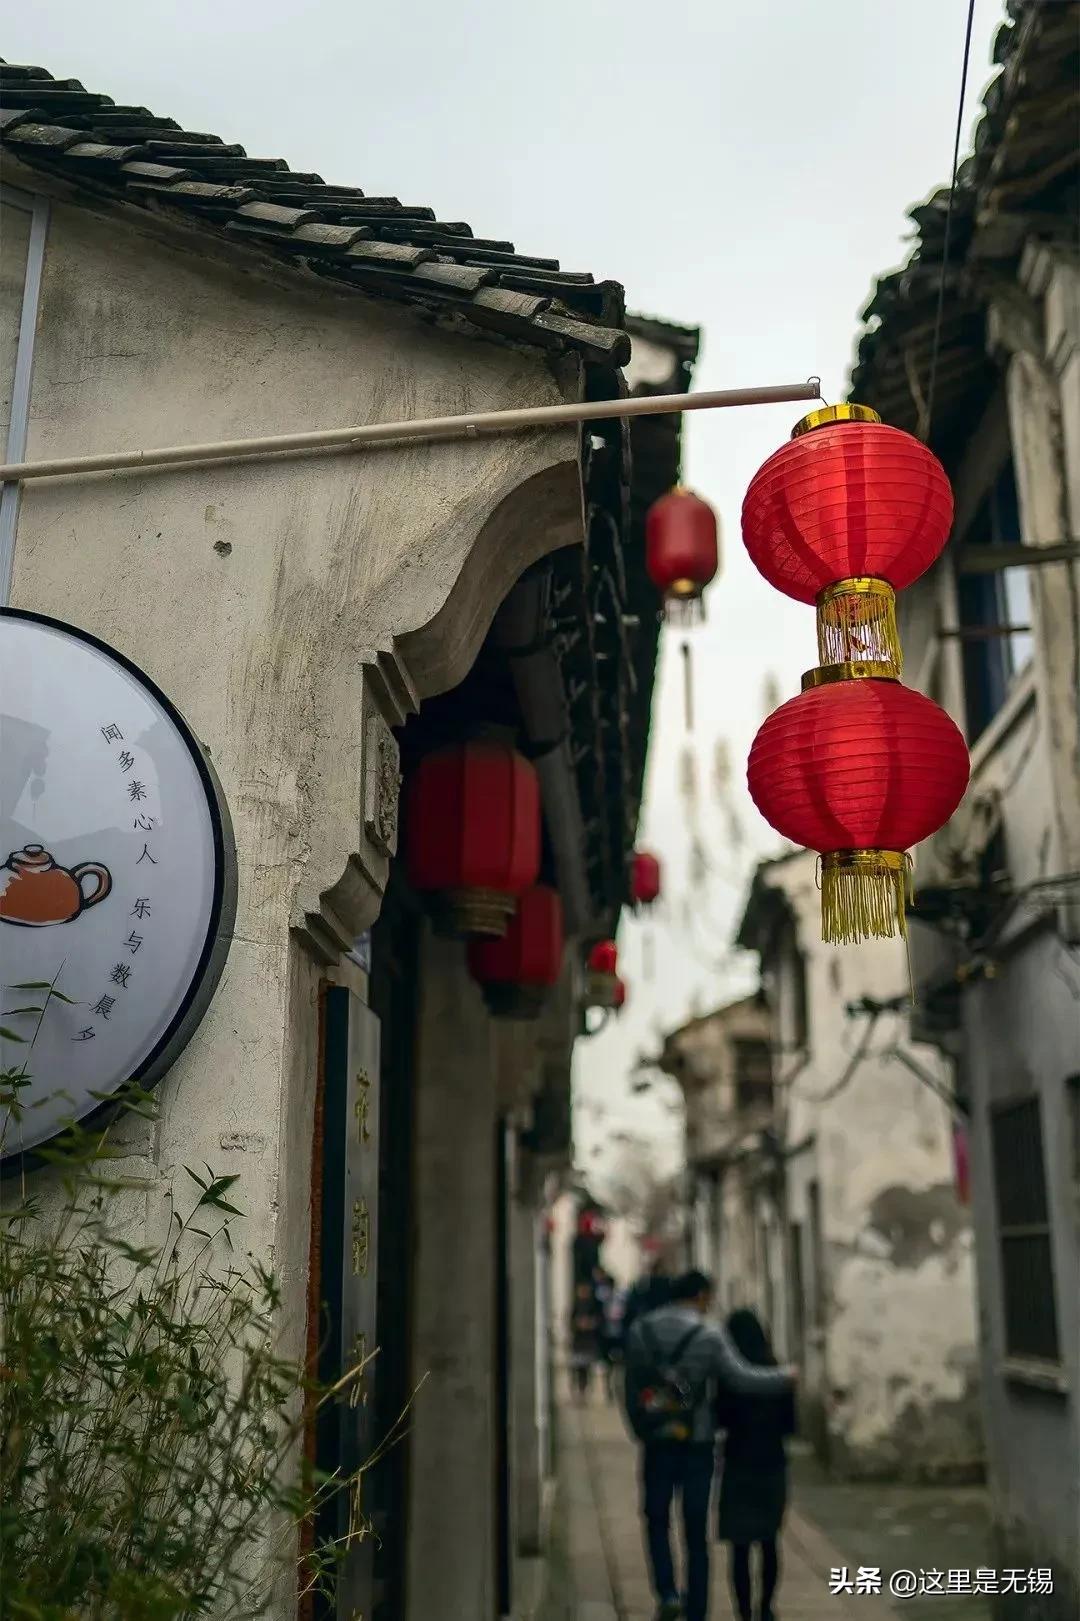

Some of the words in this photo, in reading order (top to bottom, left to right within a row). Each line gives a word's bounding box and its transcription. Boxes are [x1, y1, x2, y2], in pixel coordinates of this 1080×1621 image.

[100, 723, 158, 865] 闻多素心人
[71, 898, 151, 1042] 乐与数晨夕
